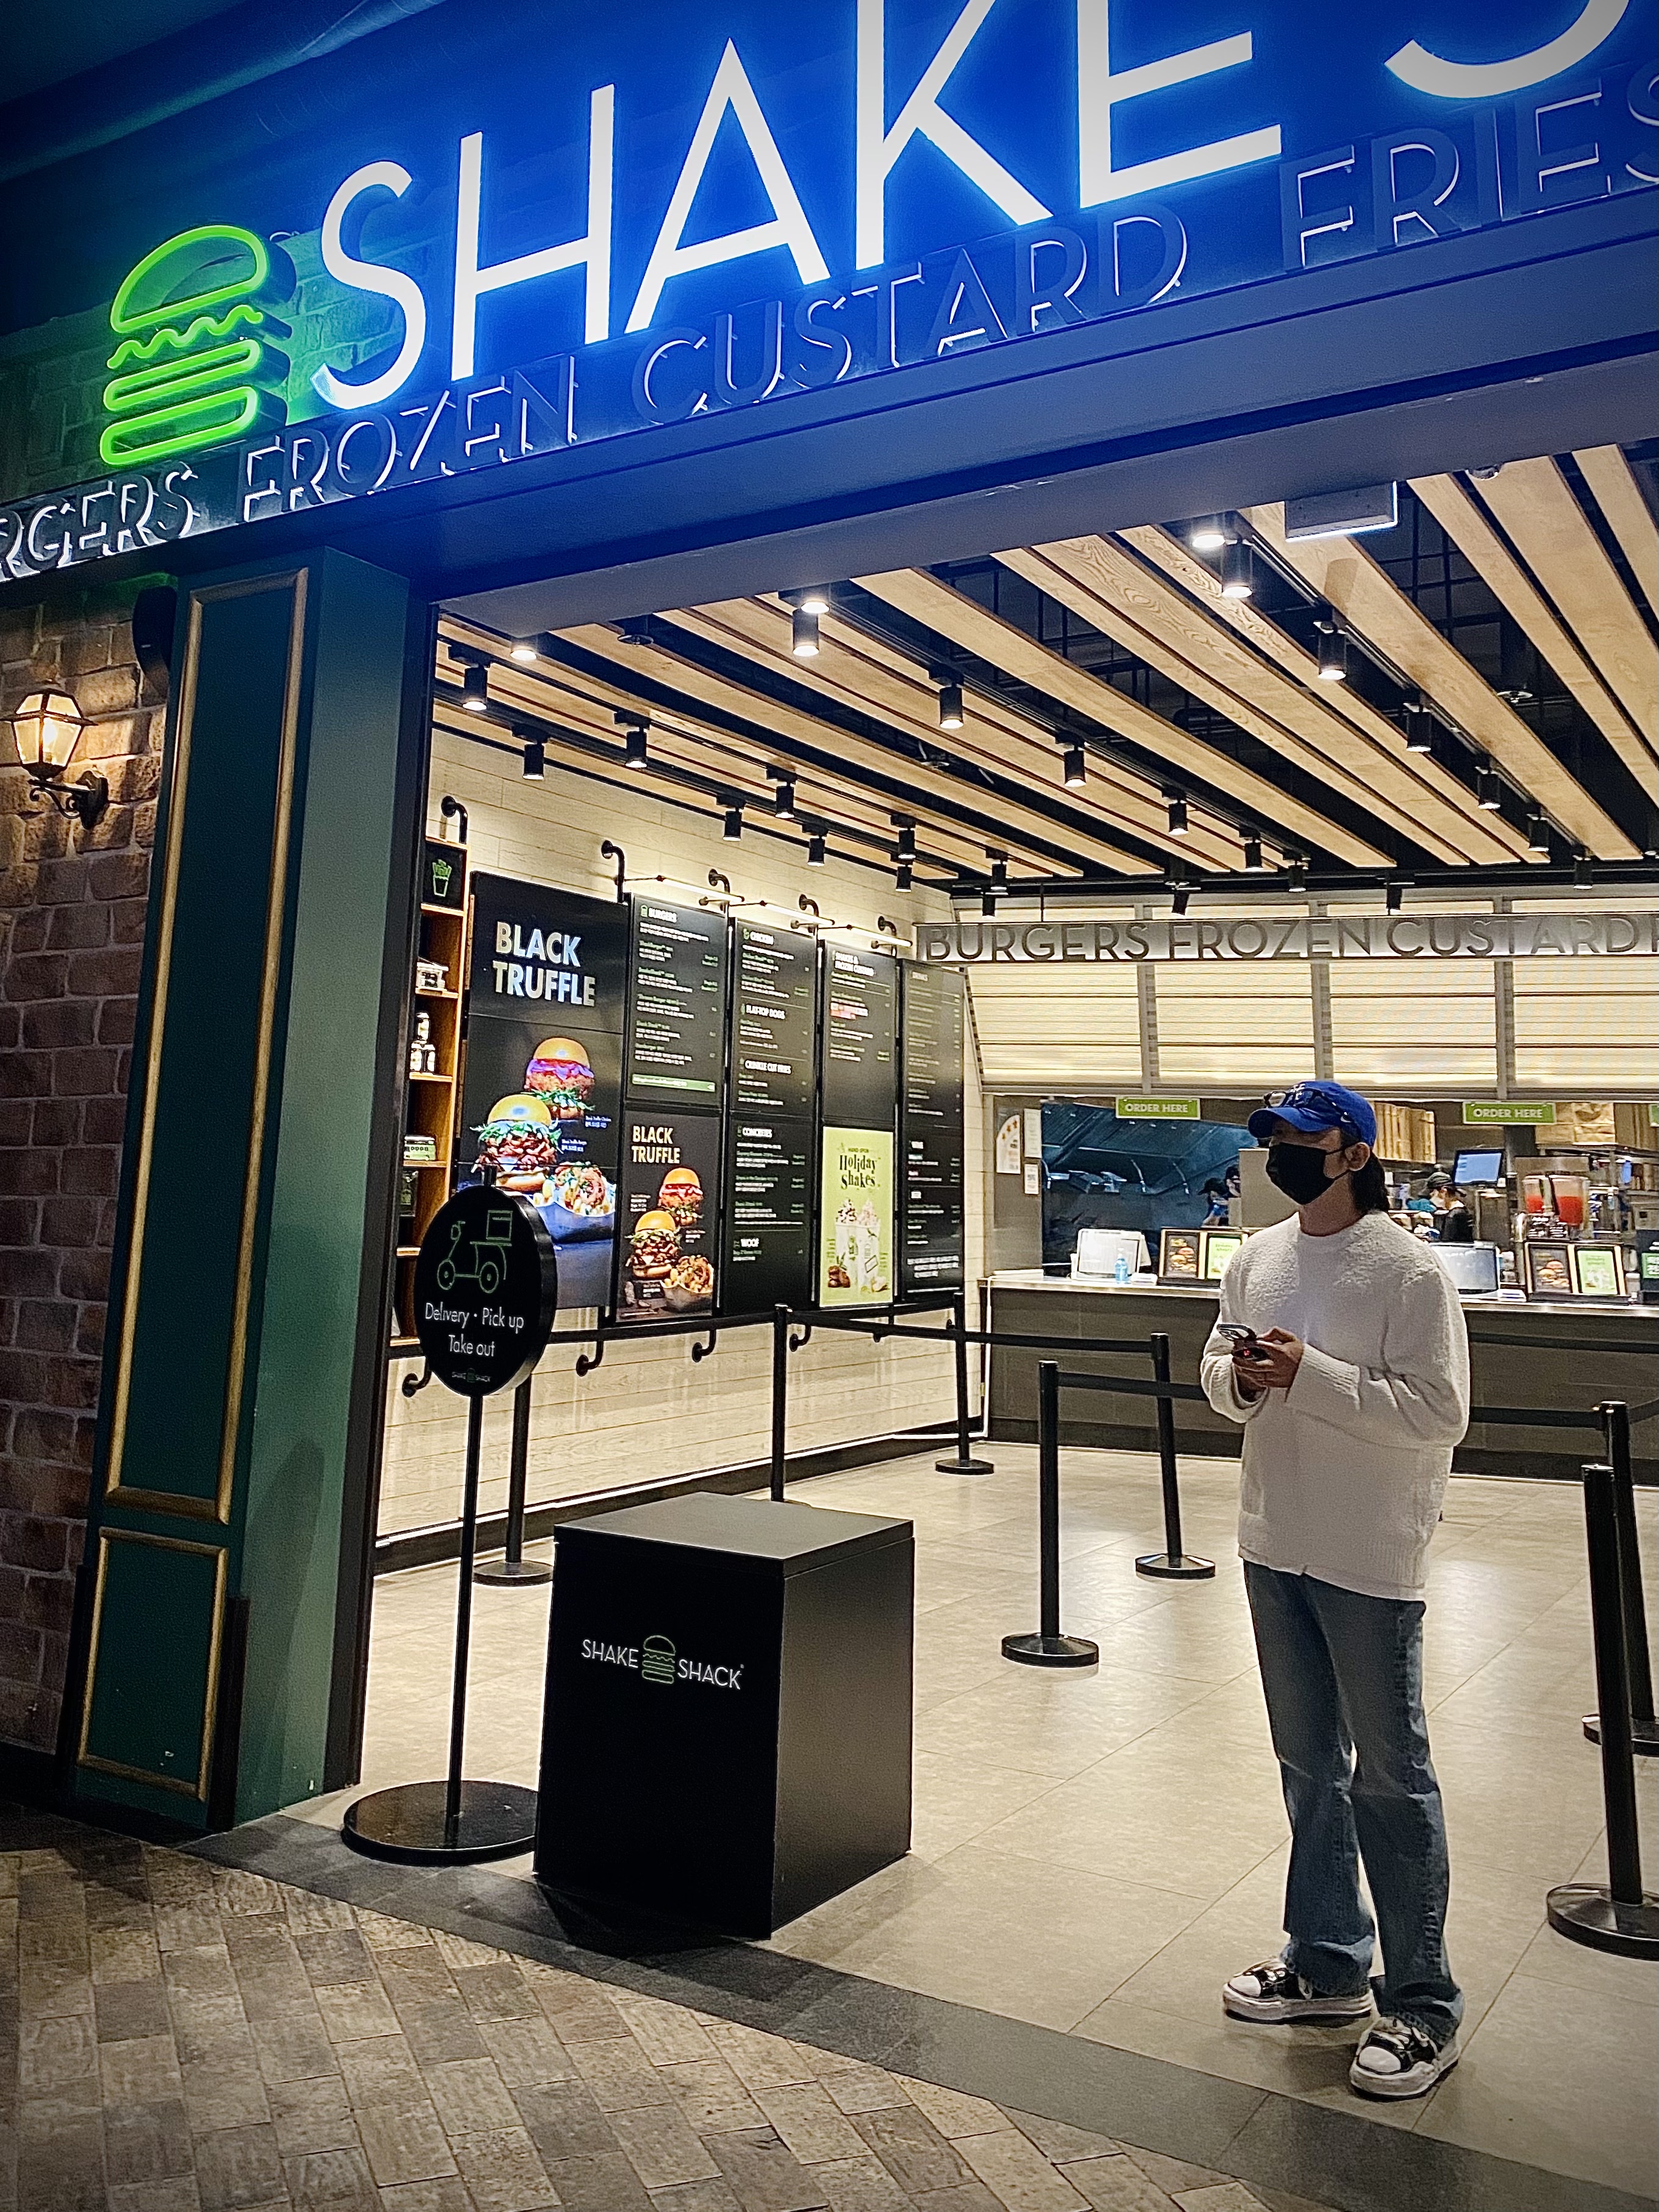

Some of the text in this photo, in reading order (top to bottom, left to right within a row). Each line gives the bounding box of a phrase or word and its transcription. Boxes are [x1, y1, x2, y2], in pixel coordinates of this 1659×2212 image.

[310, 0, 1282, 410] SHAKE
[239, 355, 577, 523] FROZEN
[632, 204, 1188, 426] CUSTARD
[495, 921, 581, 968] BLACK
[925, 921, 1149, 962] BURGERS
[1168, 919, 1371, 962] FROZEN
[1386, 915, 1639, 957] CUSTARD
[492, 960, 596, 1007] TRUFFLE
[1124, 1104, 1188, 1113] ORDER HERE
[1472, 1108, 1543, 1118] ORDER HERE
[632, 1126, 674, 1144] BLACK
[631, 1146, 680, 1164] TRUFFLE
[840, 1154, 876, 1174] Holiday
[425, 1302, 524, 1334] Delivery Pick up
[448, 1334, 496, 1357] Take out
[581, 1639, 741, 1690] SHAKE SHACK
